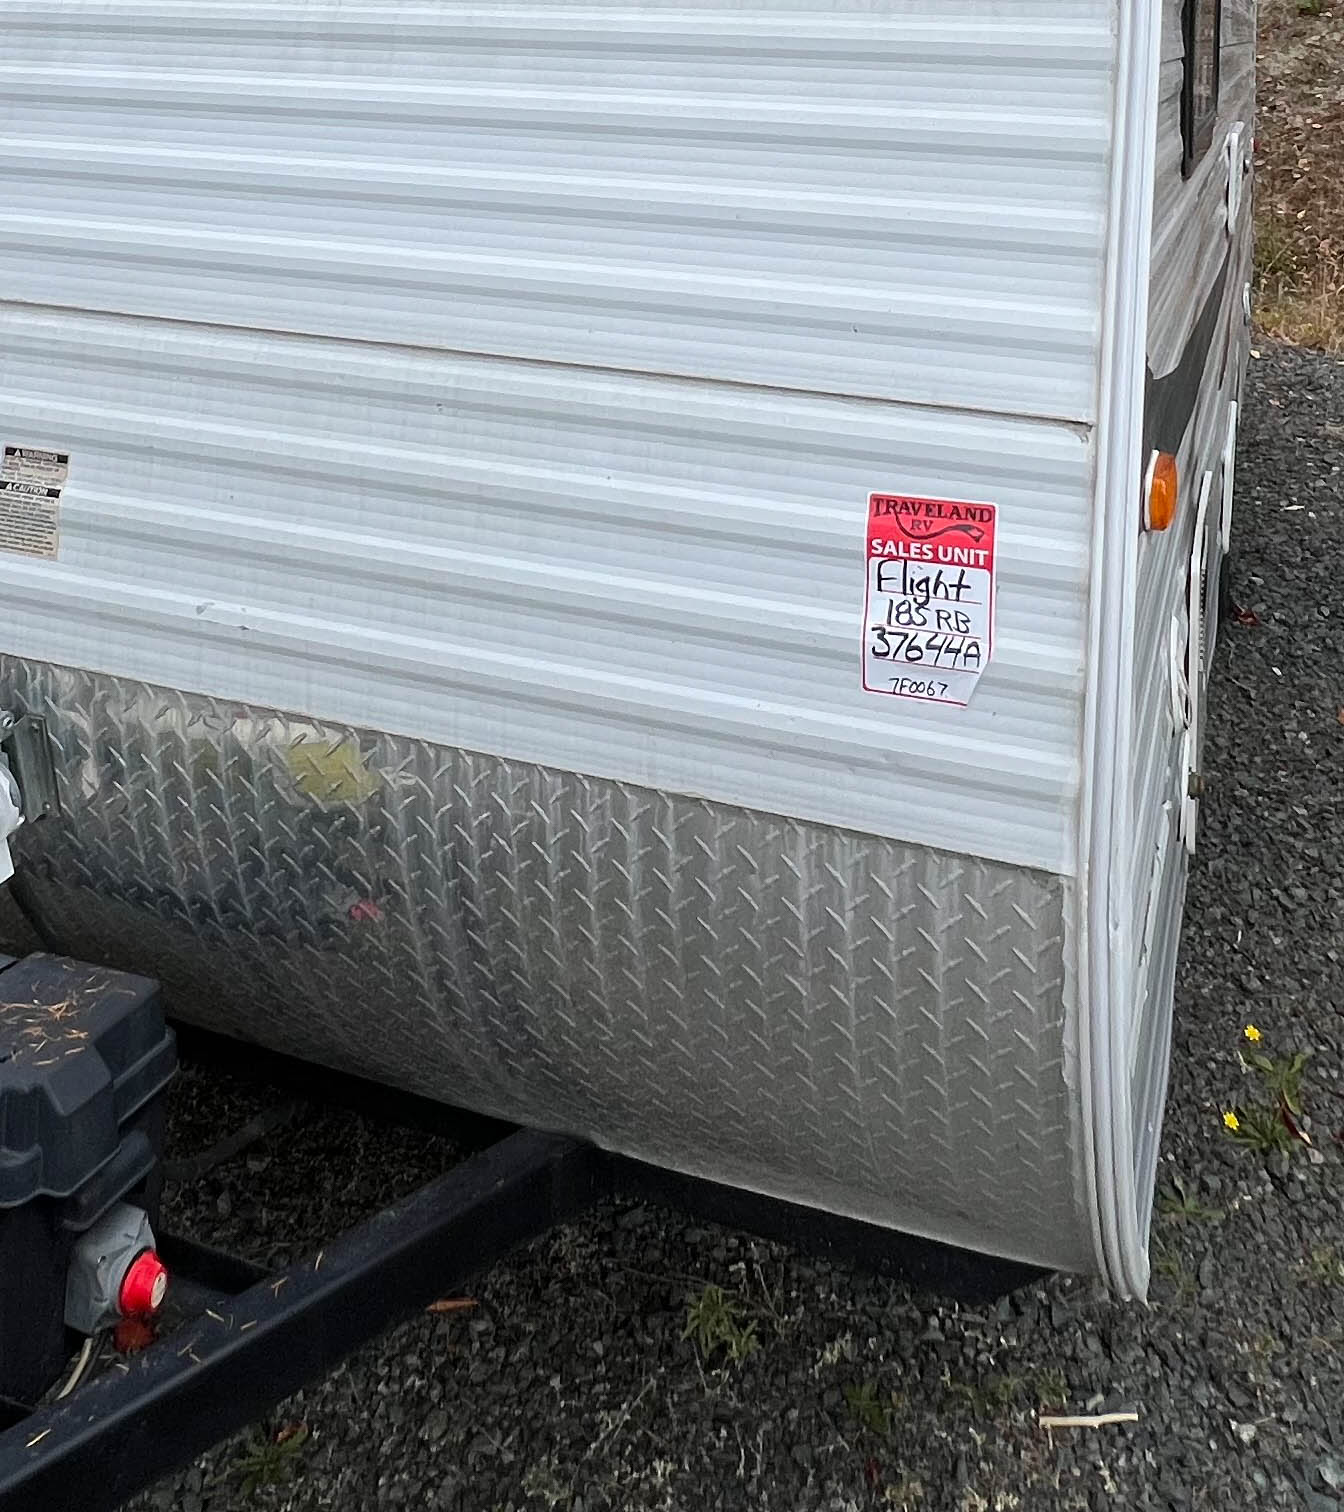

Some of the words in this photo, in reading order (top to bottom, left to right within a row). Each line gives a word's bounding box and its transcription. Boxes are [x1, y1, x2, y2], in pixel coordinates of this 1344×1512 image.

[872, 497, 994, 524] TRAVELAND
[909, 519, 935, 532] RV
[871, 538, 935, 561] SALES
[937, 545, 990, 566] UNIT
[876, 559, 972, 606] Flight
[871, 626, 982, 669] 37644A
